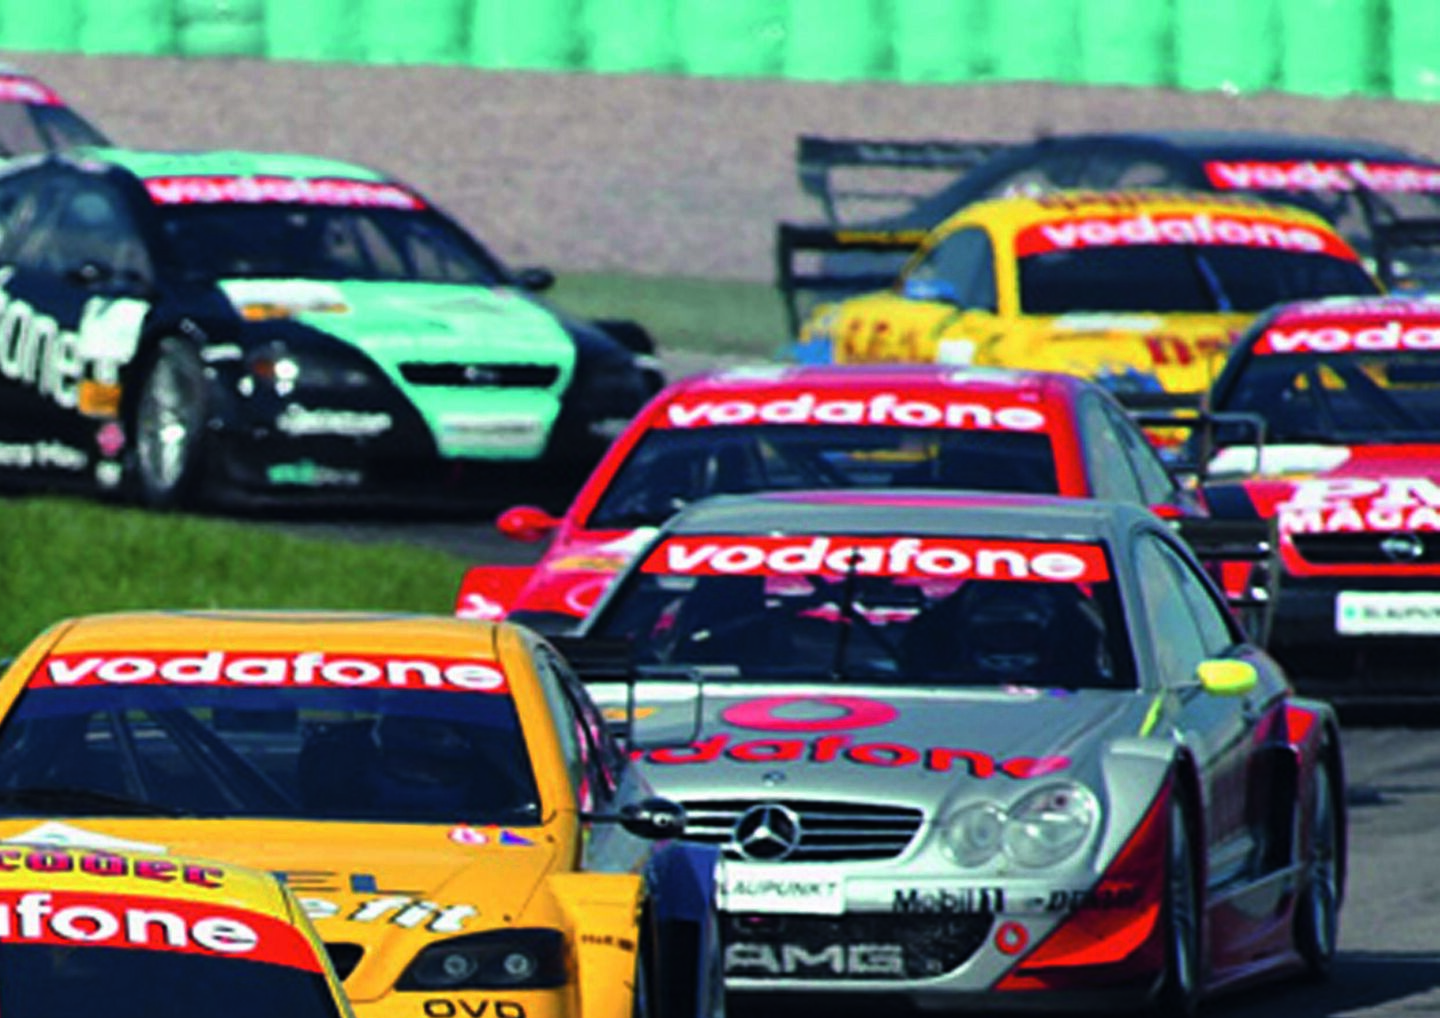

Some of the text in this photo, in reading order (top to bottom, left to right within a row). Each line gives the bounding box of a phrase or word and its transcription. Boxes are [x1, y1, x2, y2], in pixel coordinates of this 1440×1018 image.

[1041, 216, 1326, 252] vodafone
[668, 394, 1046, 431] vodafone
[667, 537, 1086, 579] vodafone
[47, 651, 505, 691] vodafone
[724, 942, 904, 975] AMG
